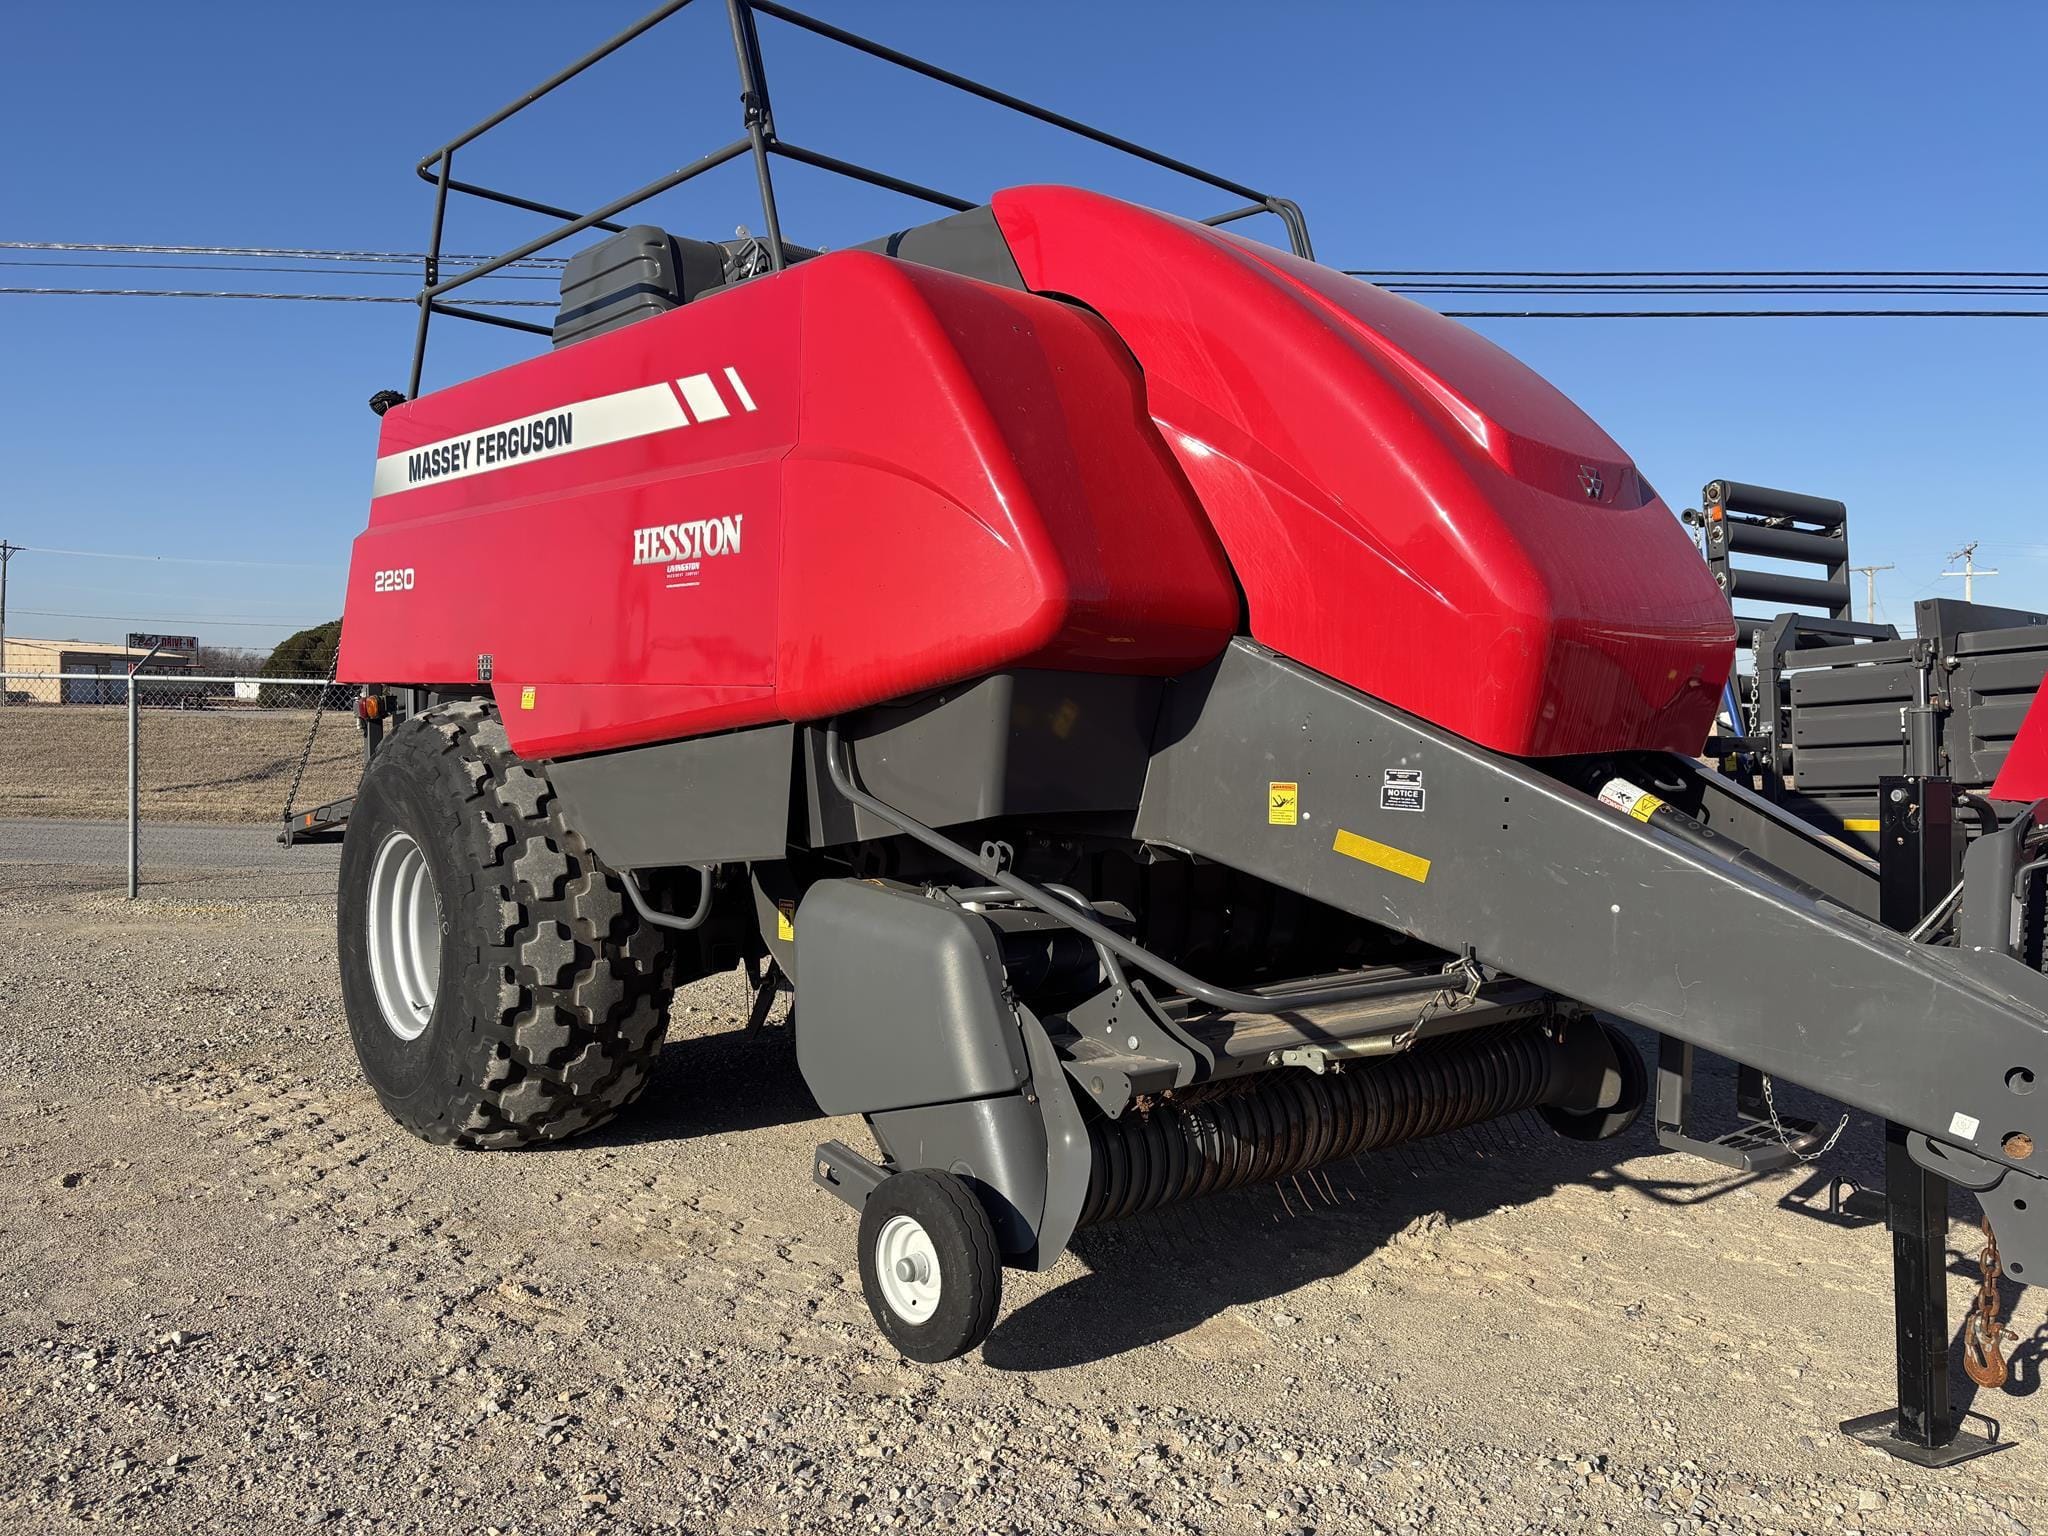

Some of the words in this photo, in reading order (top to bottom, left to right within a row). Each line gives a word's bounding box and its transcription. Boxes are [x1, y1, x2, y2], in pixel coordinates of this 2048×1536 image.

[408, 440, 471, 483] MASSEY
[476, 412, 573, 466] FERGUSON
[633, 513, 743, 565] HESSTON
[1387, 789, 1419, 797] NOTICE
